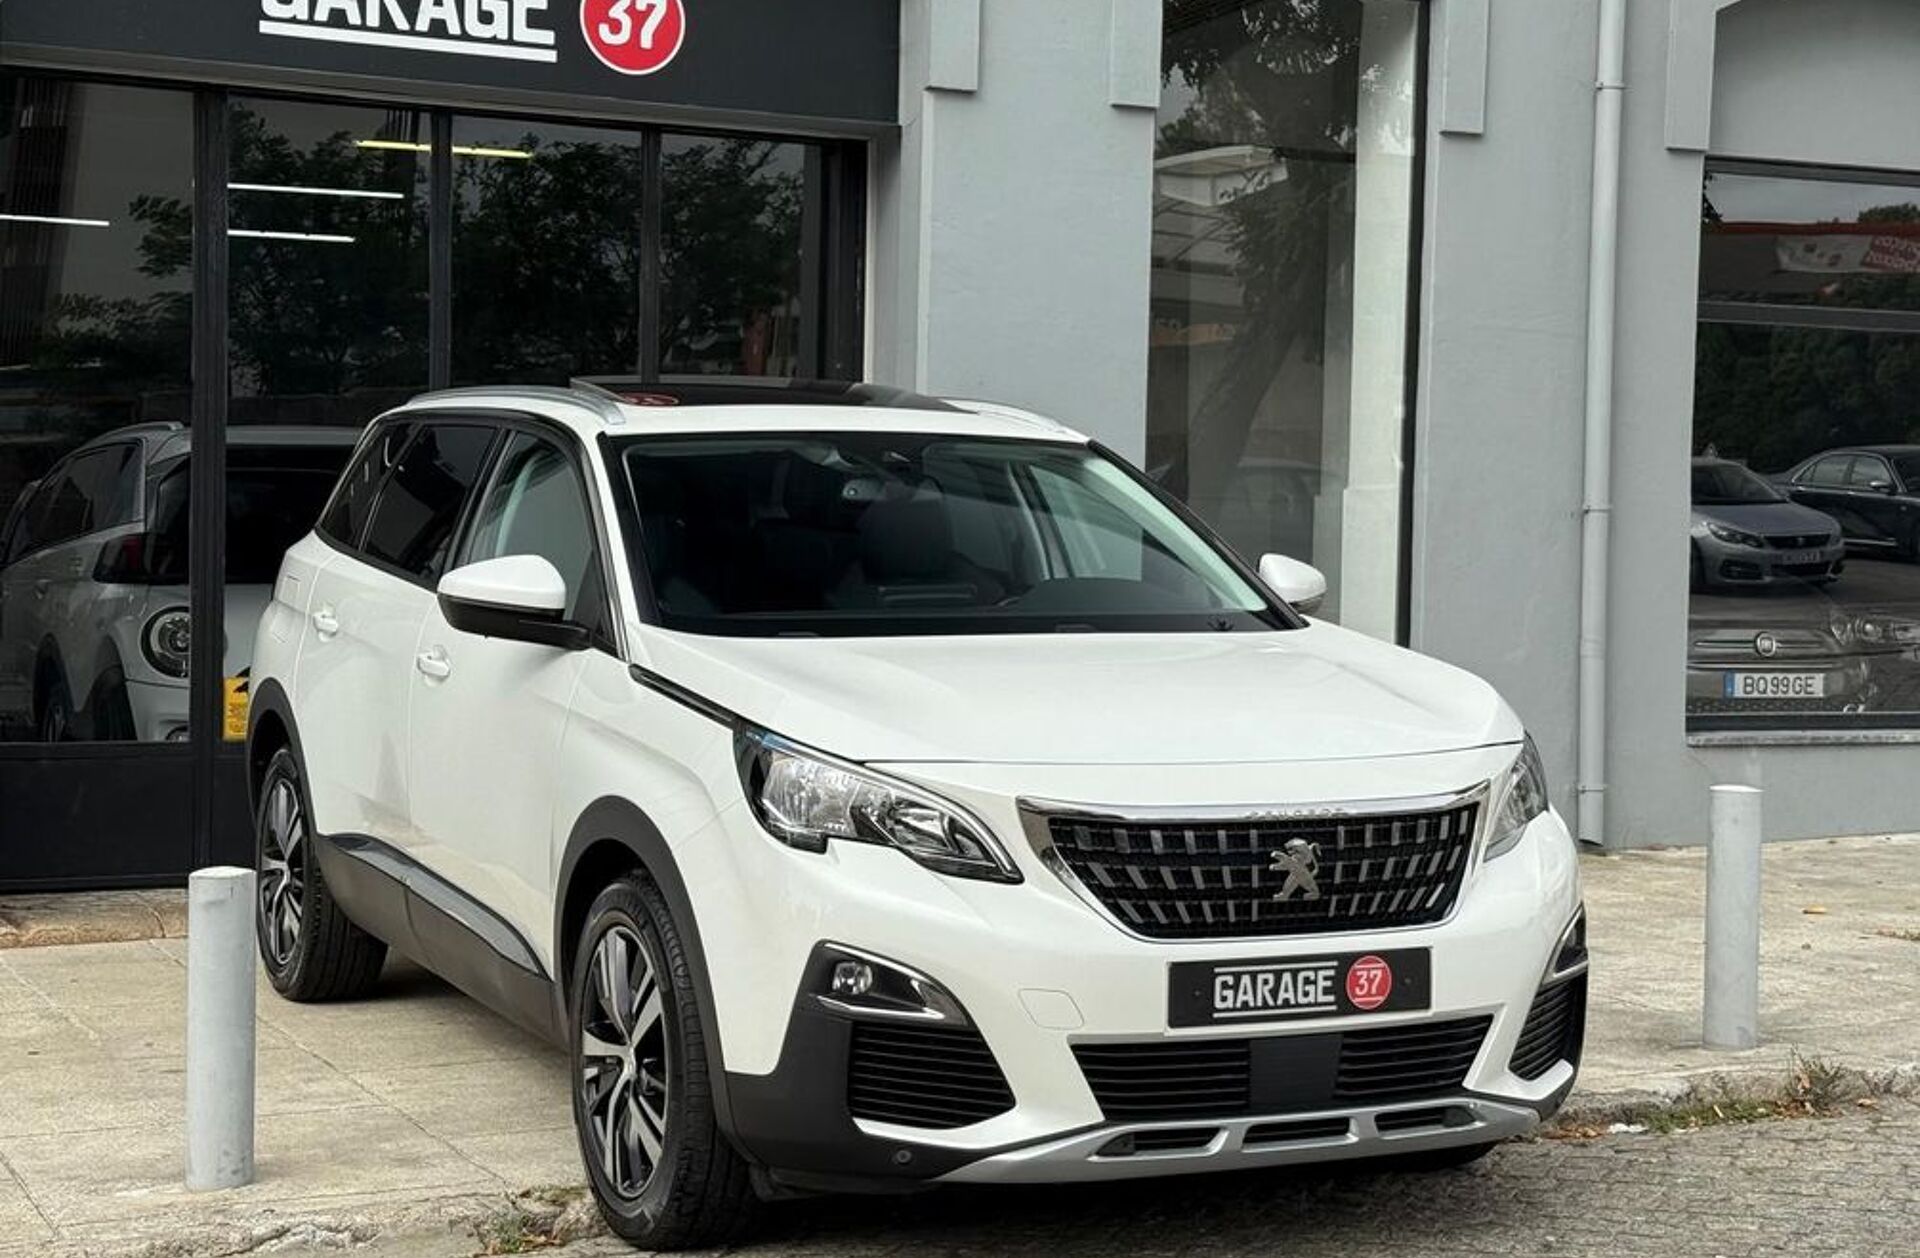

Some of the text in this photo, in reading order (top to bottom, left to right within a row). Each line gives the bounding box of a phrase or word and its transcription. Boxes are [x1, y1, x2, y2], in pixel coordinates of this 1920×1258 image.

[261, 0, 668, 49] AGE 37
[1214, 969, 1384, 1010] GARAGE 37
